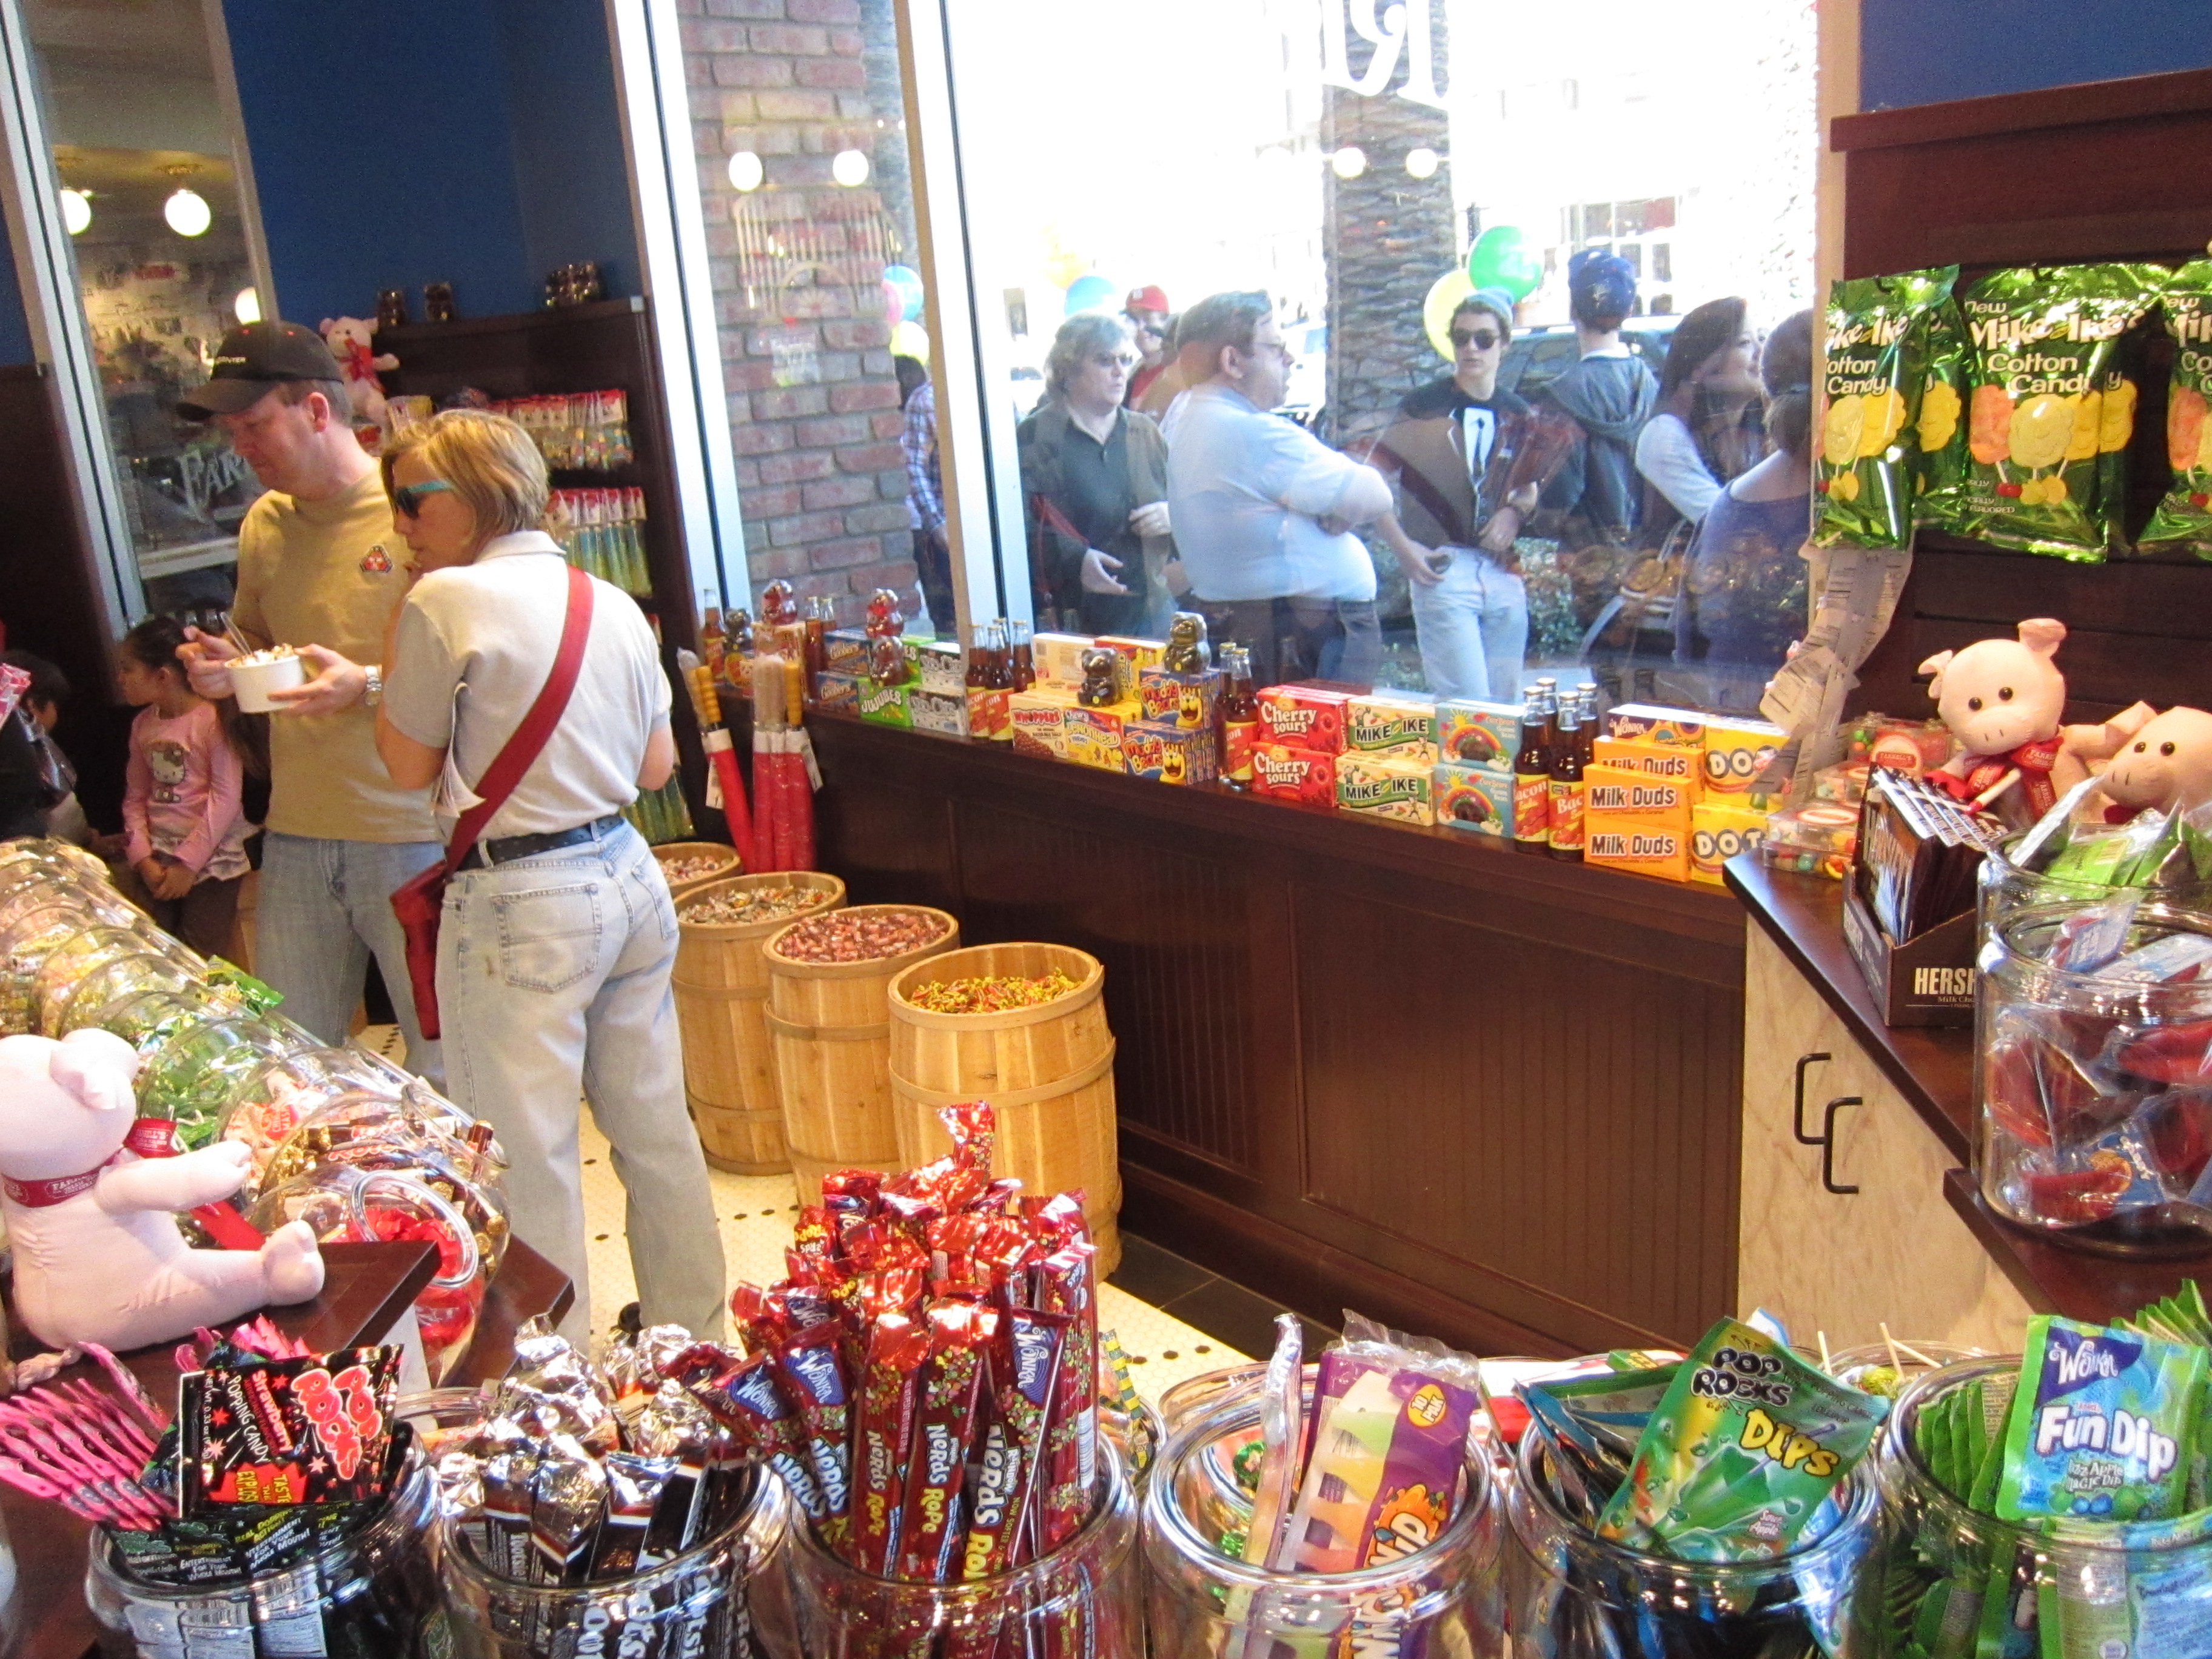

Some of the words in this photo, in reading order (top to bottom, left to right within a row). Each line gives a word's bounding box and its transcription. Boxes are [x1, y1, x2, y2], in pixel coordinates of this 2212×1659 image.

[1969, 315, 2054, 351] Mike
[1826, 355, 1877, 375] otton
[1986, 353, 2079, 373] Cotton
[1828, 375, 1888, 395] Candy
[1261, 700, 1318, 724] Cherry
[1273, 720, 1308, 734] sours
[1355, 724, 1392, 742] MIKE
[1402, 717, 1428, 733] IKE
[1253, 751, 1312, 776] Cherry
[1643, 756, 1687, 776] Duds
[1267, 771, 1301, 785] sours
[1344, 781, 1382, 800] MIKE
[1392, 778, 1418, 793] IKE
[1515, 780, 1547, 802] acon
[1557, 794, 1584, 814] Bac
[1590, 787, 1628, 807] Milk
[1632, 785, 1677, 806] Duds
[1590, 834, 1628, 855] Milk
[1632, 834, 1676, 854] Duds
[1692, 827, 1766, 859] DOT
[1914, 968, 1976, 995] HERSH
[1015, 1326, 1049, 1389] WONKA
[1711, 1346, 1784, 1378] POP
[2048, 1340, 2119, 1385] WONKA
[795, 1349, 835, 1404] WONKA
[1691, 1367, 1793, 1408] ROCKS
[332, 1364, 383, 1441] POP
[736, 1372, 779, 1420] WONKA
[1411, 1393, 1429, 1412] 10
[1421, 1395, 1446, 1423] PAK
[227, 1373, 256, 1426] POPPING
[243, 1425, 271, 1464] CANDY
[252, 1369, 294, 1452] Strawberry
[924, 1423, 950, 1485] NeRdS
[1738, 1407, 1842, 1478] DIPS
[2035, 1405, 2109, 1458] Fun
[2109, 1407, 2179, 1484] Dip
[974, 1424, 1008, 1526] NeRdS
